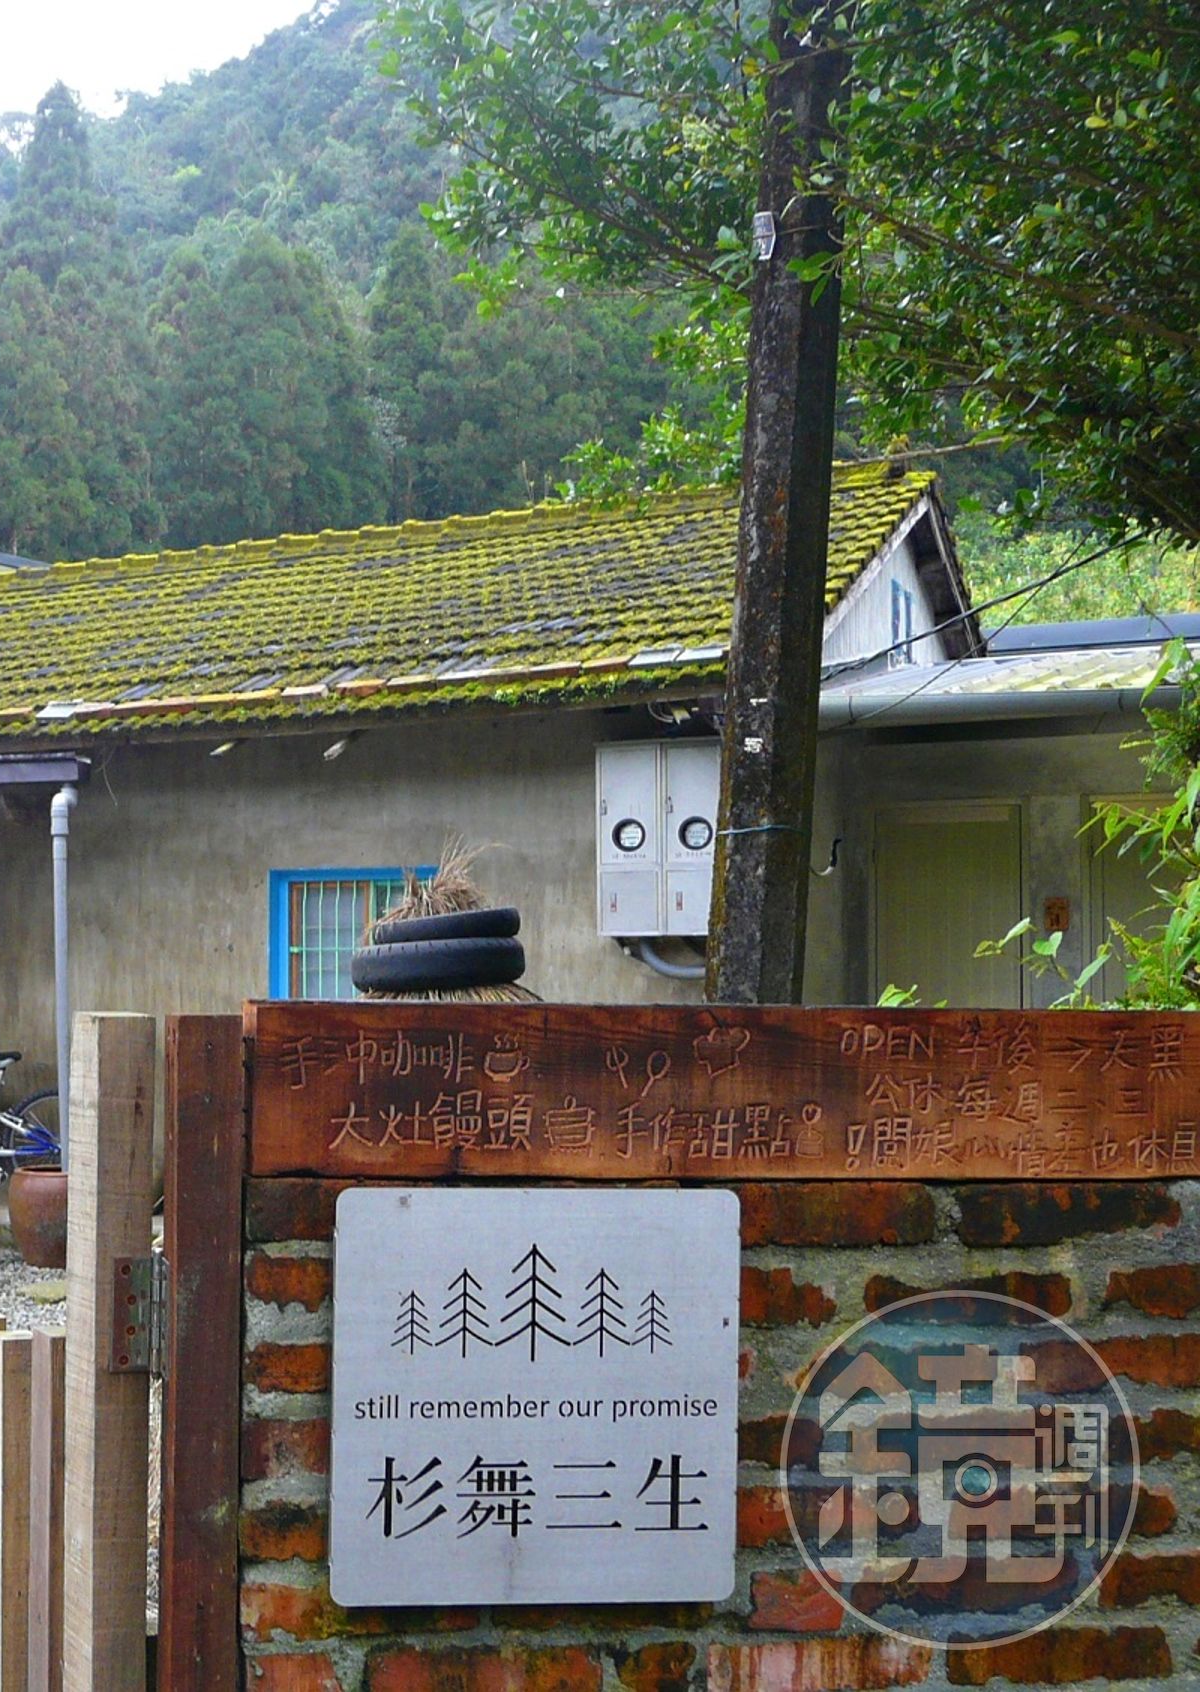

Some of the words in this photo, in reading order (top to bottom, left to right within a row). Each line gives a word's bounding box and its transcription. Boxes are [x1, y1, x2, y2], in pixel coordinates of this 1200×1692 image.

[280, 1030, 475, 1090] 手沖咖啡
[328, 1089, 535, 1152] 大灶饅頭
[615, 1100, 792, 1160] 手作甜點
[354, 1394, 400, 1420] still
[409, 1393, 551, 1420] remember
[558, 1398, 604, 1418] our
[612, 1393, 718, 1423] promise
[365, 1453, 709, 1540] 杉舞三生
